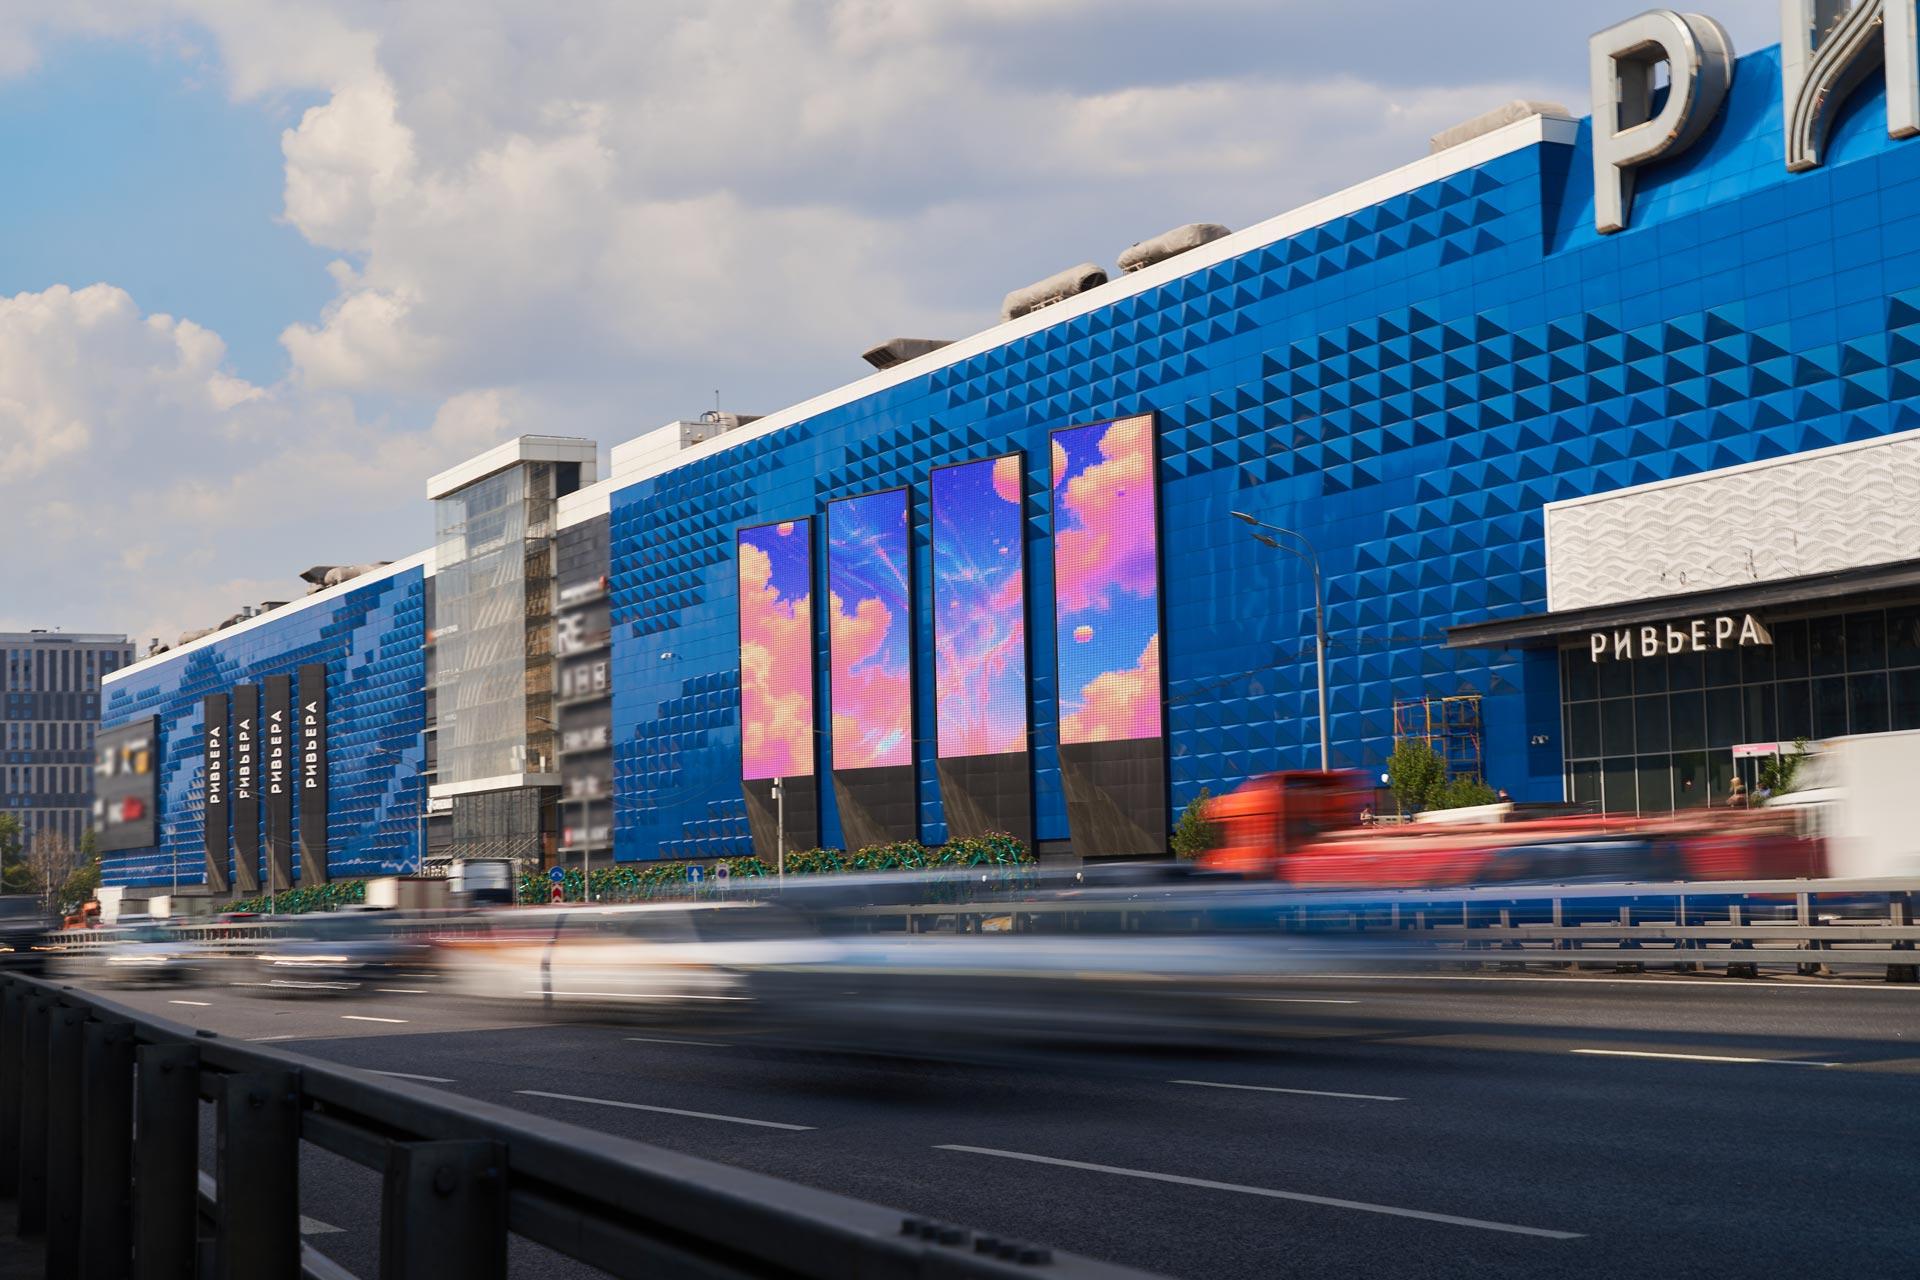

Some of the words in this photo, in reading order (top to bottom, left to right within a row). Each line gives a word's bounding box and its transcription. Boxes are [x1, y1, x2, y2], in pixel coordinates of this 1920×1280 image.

[1590, 613, 1766, 664] РИВЬЕРА
[209, 726, 221, 804] РИВЬЕРА
[239, 718, 250, 799] РИВЬЕРА
[270, 710, 282, 794] РИВЬЕРА
[305, 701, 318, 789] РИВЬЕРА
